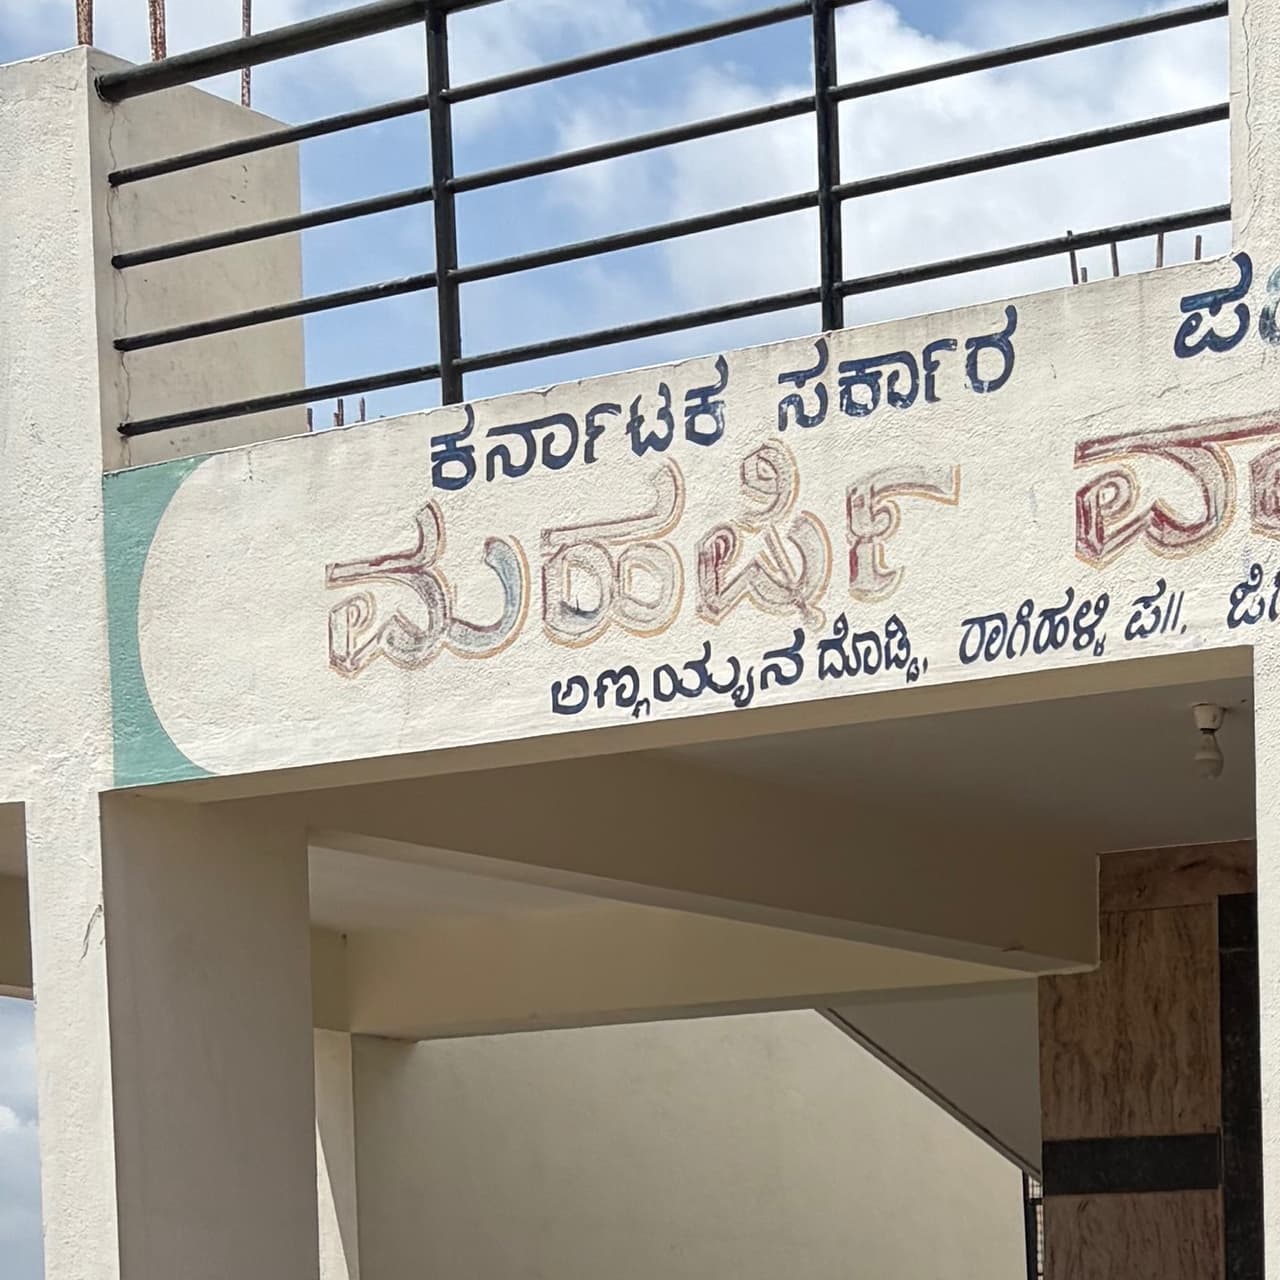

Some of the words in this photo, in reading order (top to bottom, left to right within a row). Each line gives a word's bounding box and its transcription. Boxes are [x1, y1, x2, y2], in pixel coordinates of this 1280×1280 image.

[431, 354, 729, 490] ಕರ್ನಾಟಕ
[779, 305, 1017, 431] ಸರ್ಕಾರ
[325, 438, 962, 677] ಮಹರ್ಷಿ
